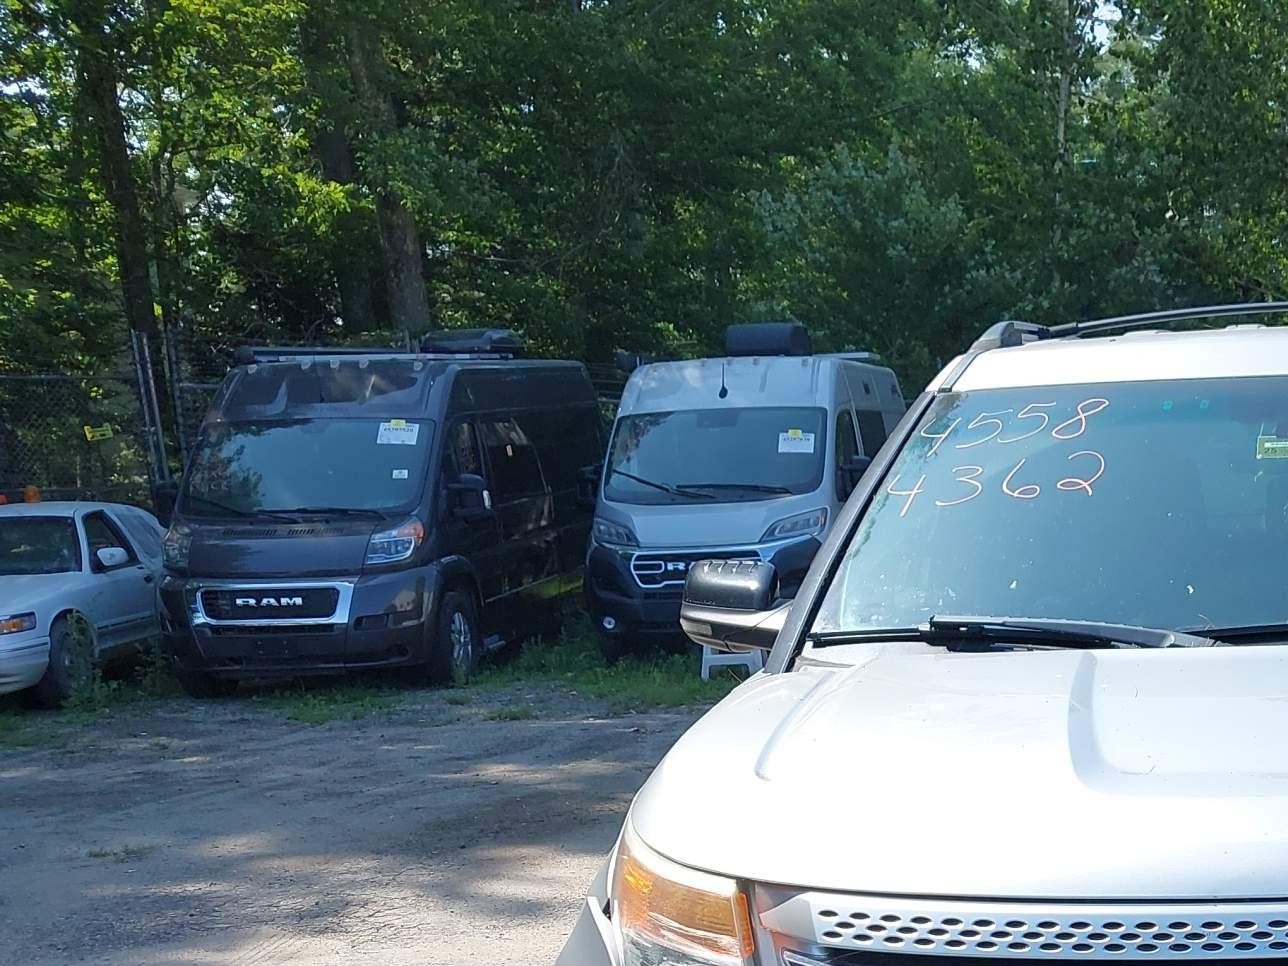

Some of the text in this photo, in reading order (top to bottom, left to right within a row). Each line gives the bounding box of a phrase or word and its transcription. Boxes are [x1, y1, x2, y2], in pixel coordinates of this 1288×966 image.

[920, 398, 1110, 457] 4558
[887, 450, 1106, 518] 4362
[236, 597, 303, 607] RAM
